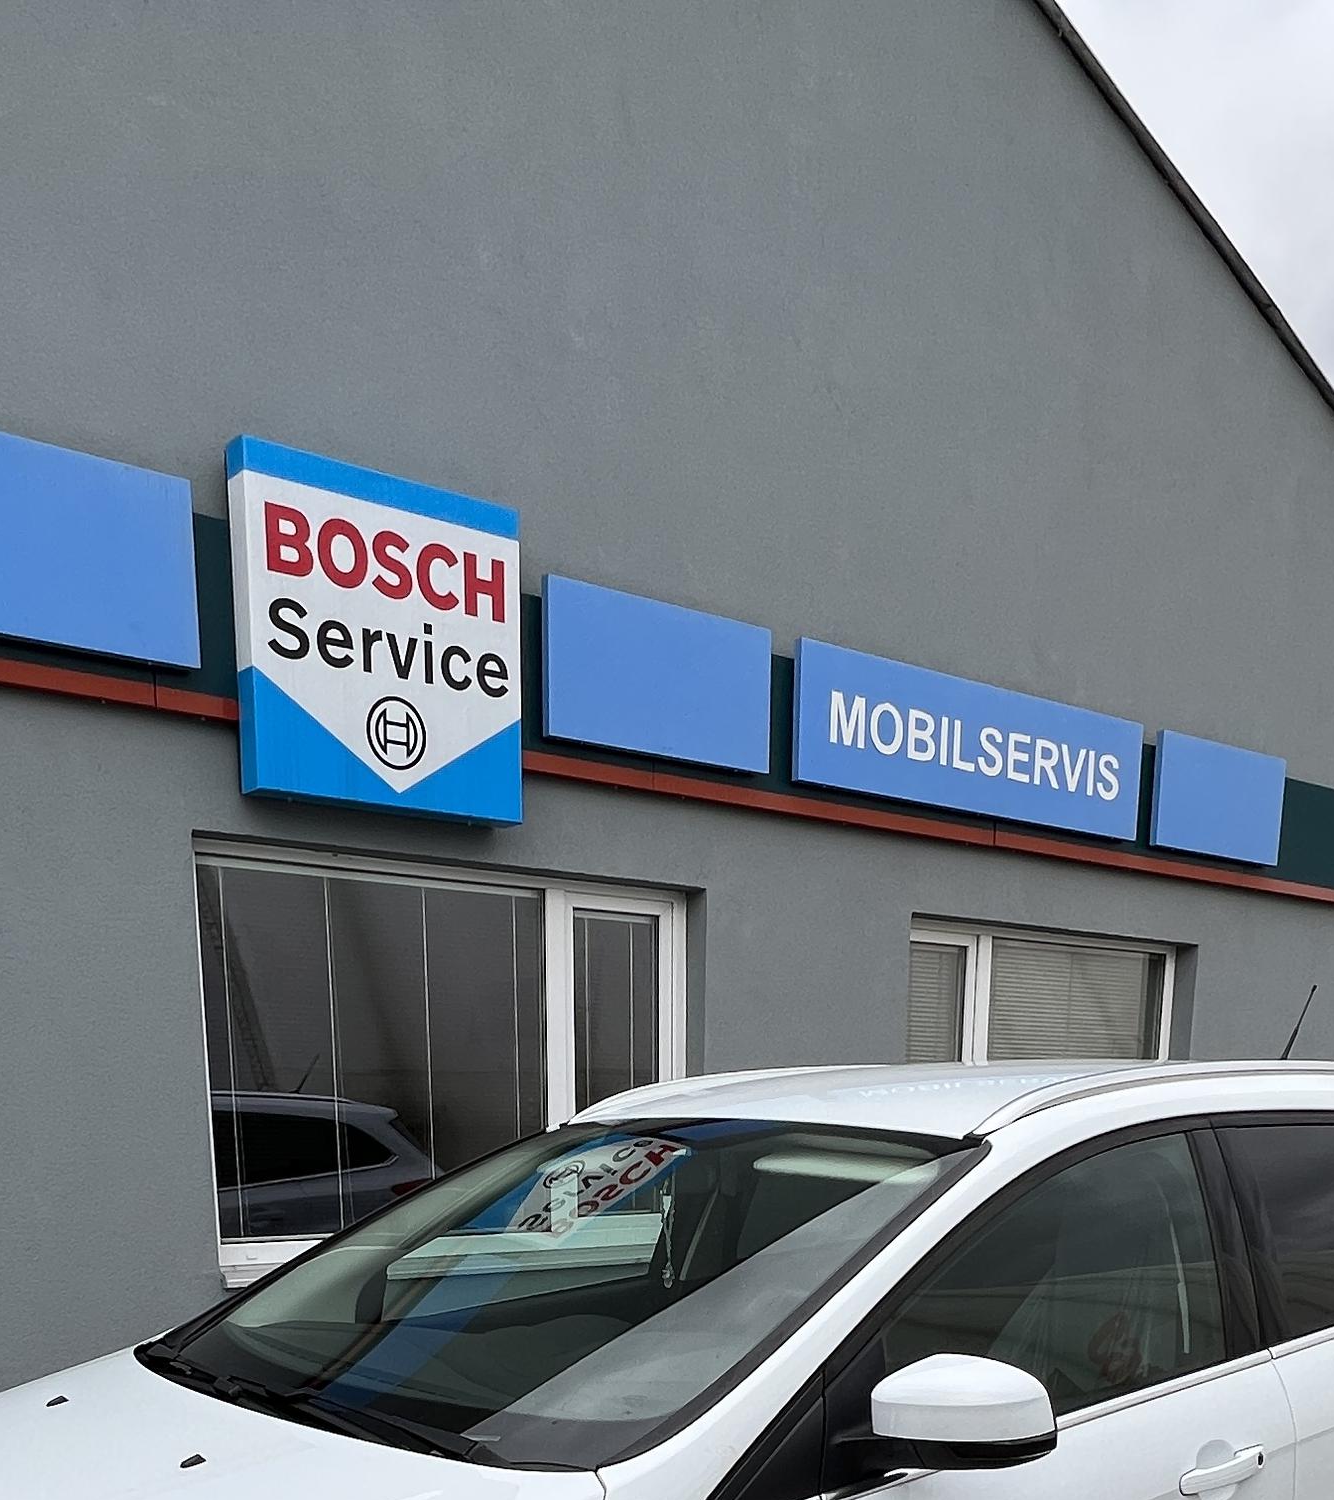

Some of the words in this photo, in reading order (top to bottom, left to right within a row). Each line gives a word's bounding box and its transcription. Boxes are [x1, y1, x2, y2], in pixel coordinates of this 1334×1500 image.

[265, 503, 505, 622] BOSCH
[268, 597, 509, 698] Service
[830, 691, 1119, 800] MOBILSERVIS
